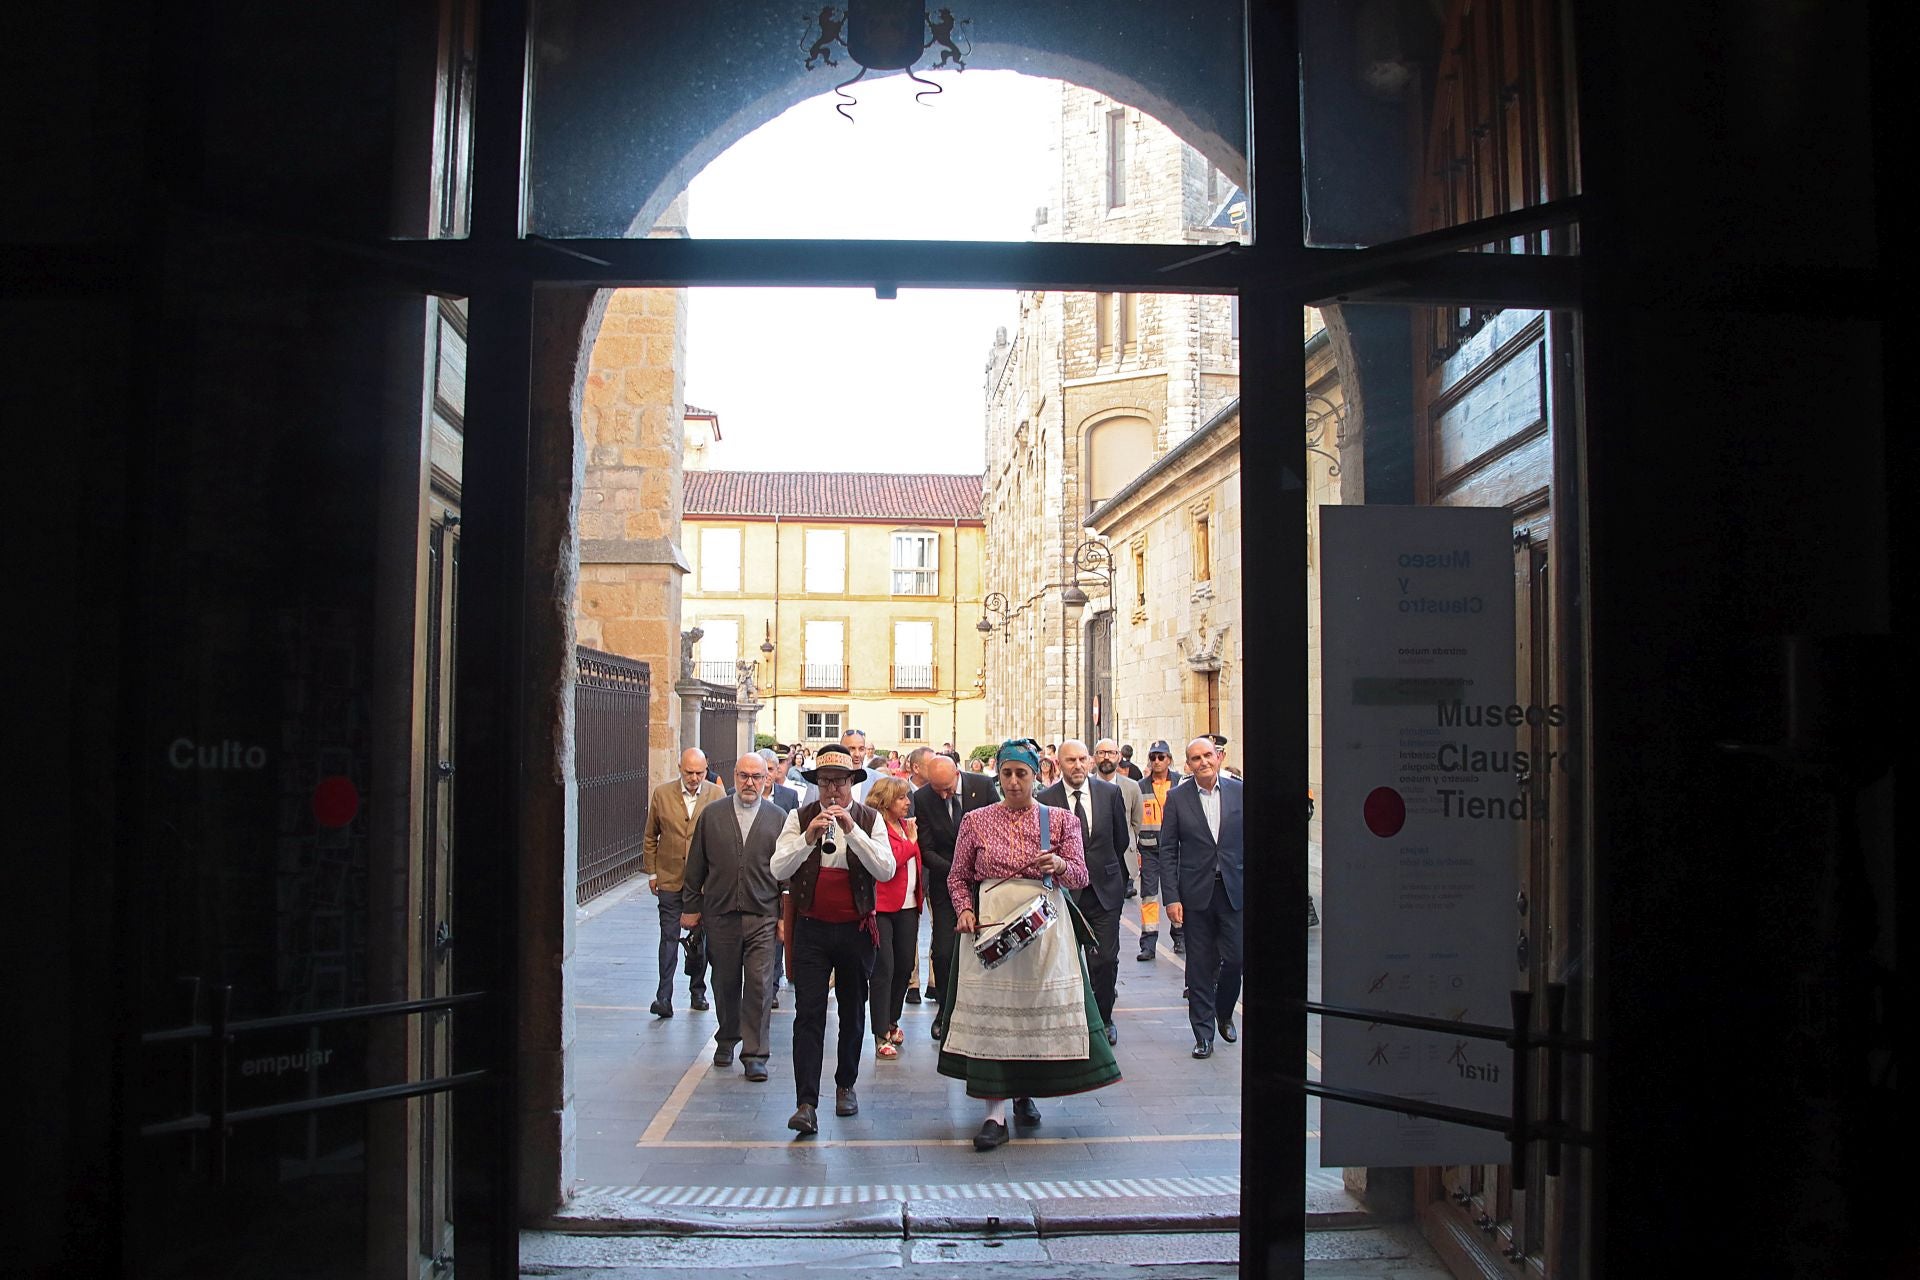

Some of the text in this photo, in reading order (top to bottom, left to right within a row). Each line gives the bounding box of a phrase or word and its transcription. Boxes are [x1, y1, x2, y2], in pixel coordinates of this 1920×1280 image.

[1437, 699, 1567, 728] Museos
[168, 737, 268, 769] Culto
[241, 1046, 334, 1076] empujar
